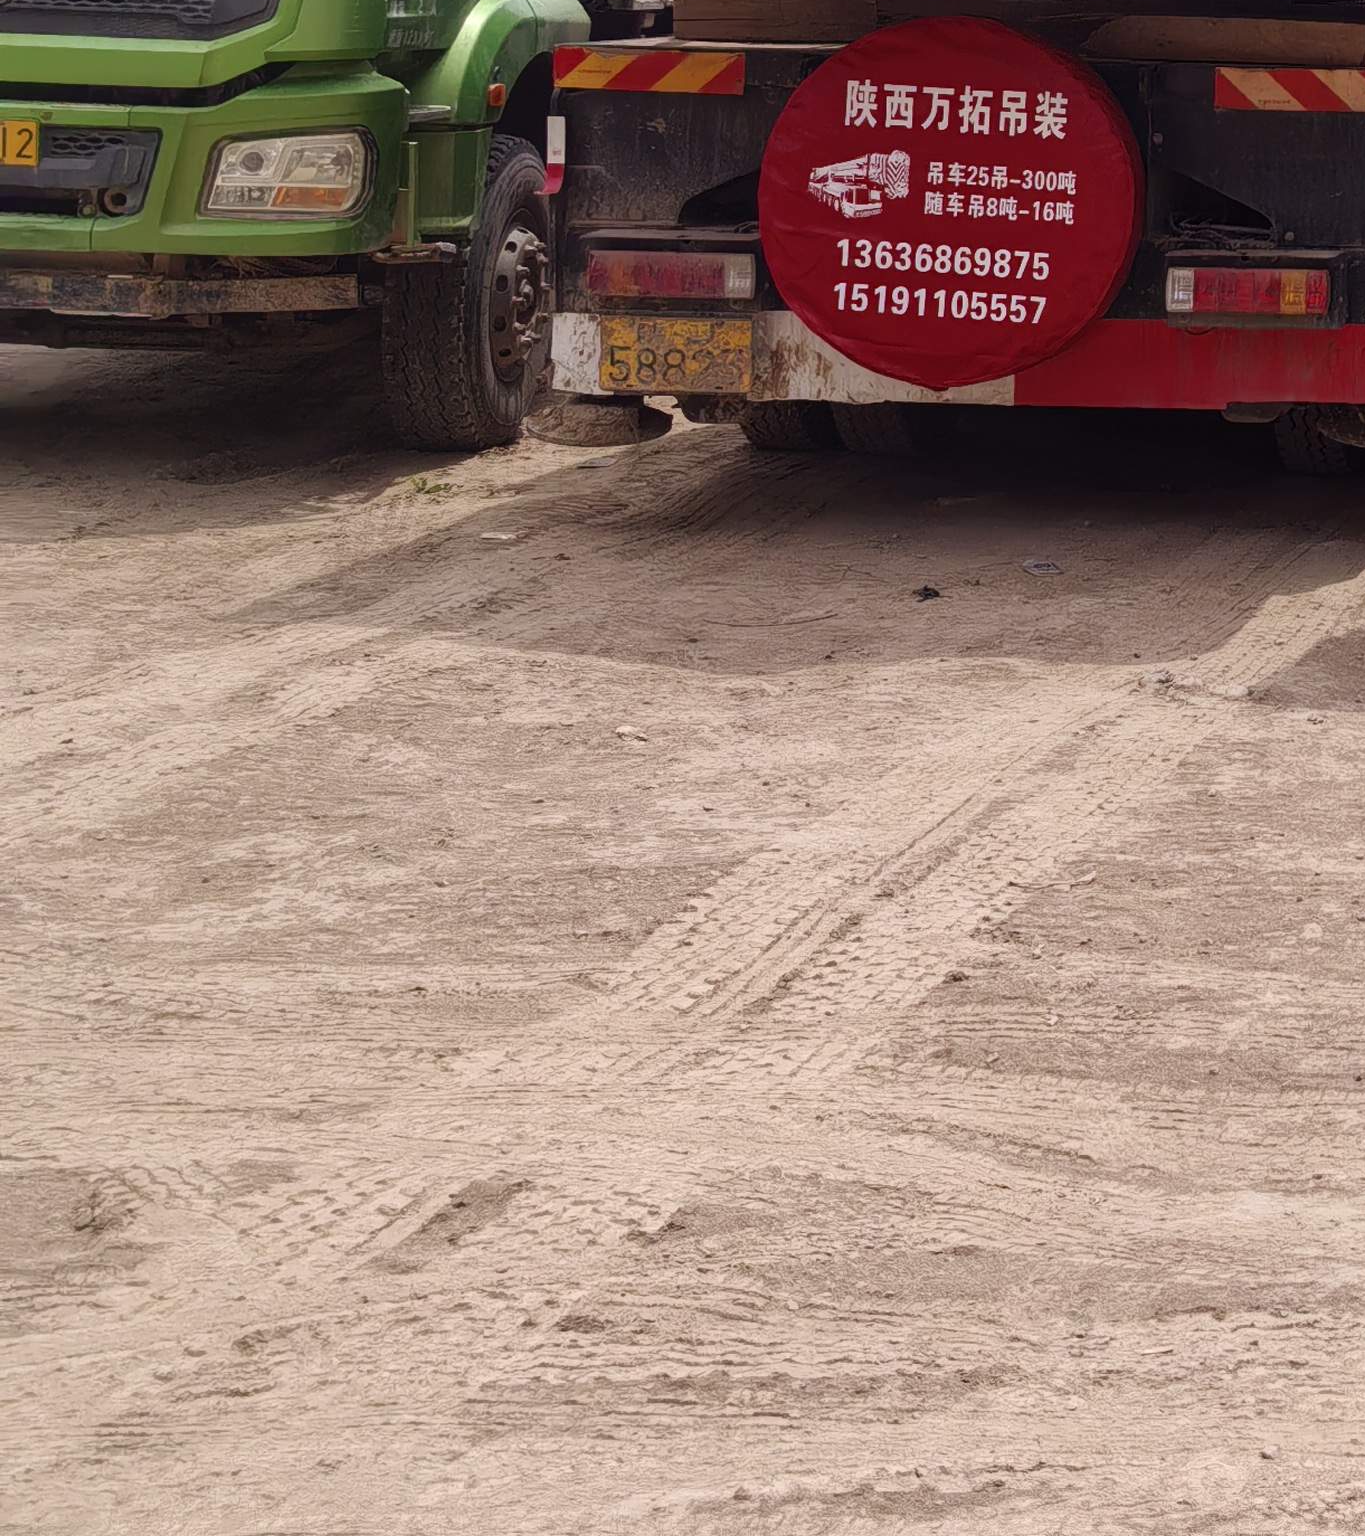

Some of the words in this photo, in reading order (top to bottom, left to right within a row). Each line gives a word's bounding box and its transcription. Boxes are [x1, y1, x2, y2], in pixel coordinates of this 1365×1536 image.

[844, 78, 1069, 142] 陕西万拓吊装
[835, 237, 1051, 282] 13636869875
[832, 281, 1048, 326] 15191105557
